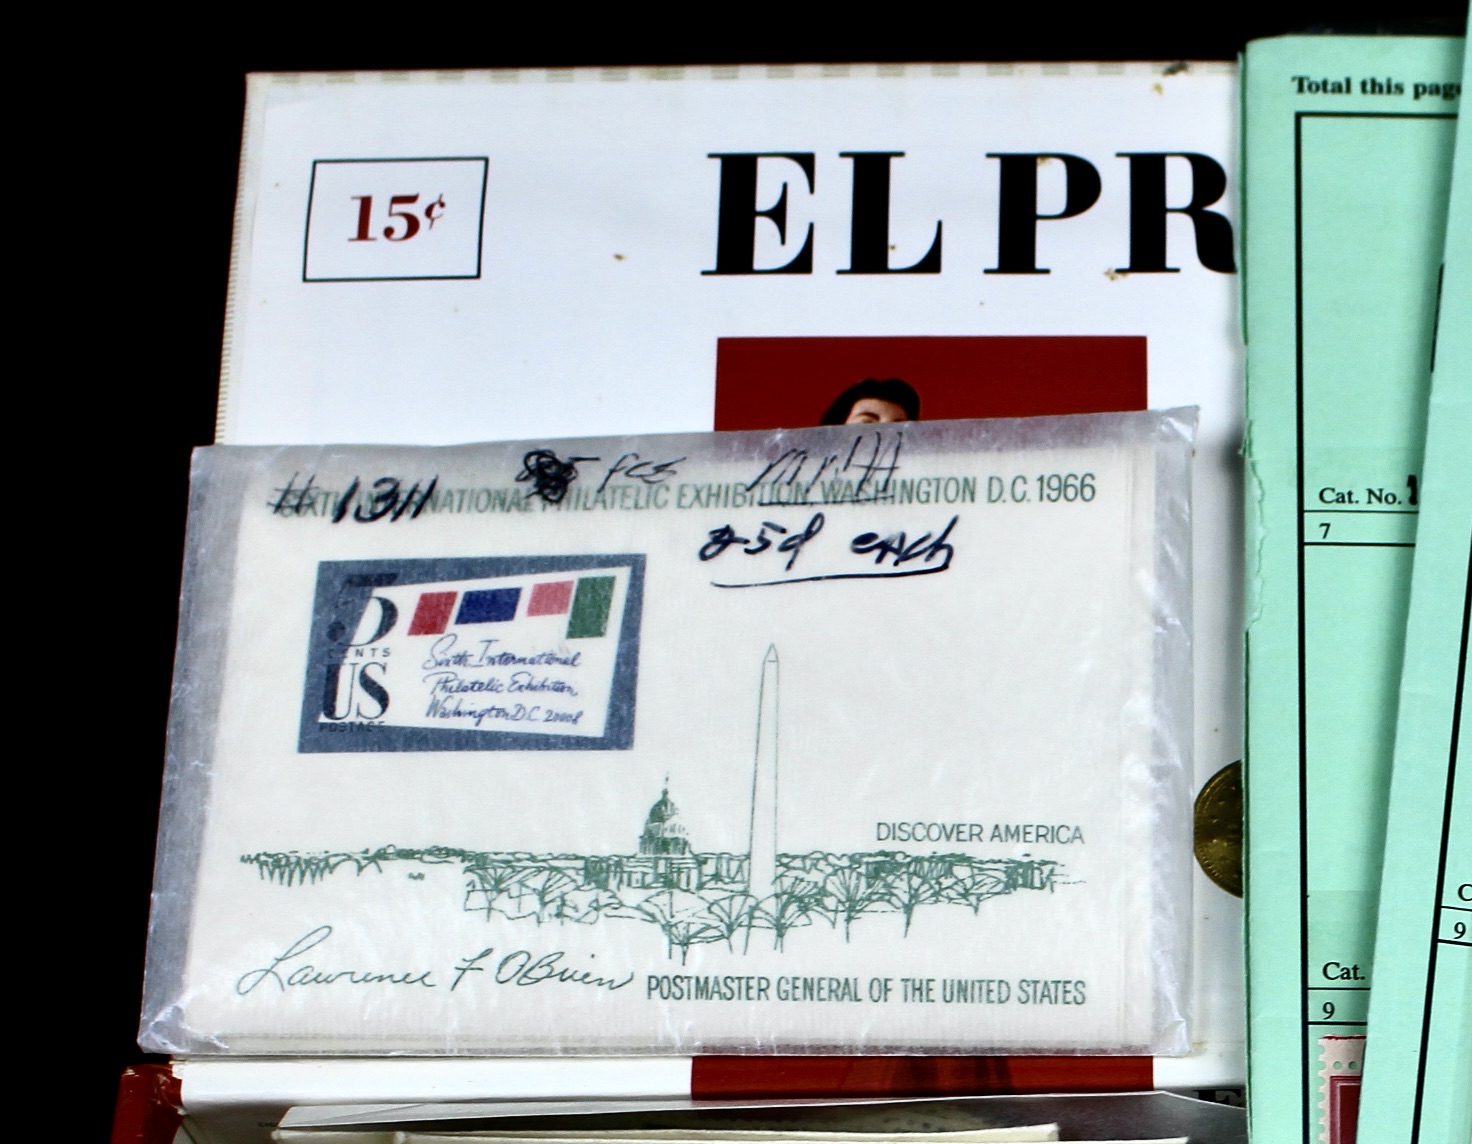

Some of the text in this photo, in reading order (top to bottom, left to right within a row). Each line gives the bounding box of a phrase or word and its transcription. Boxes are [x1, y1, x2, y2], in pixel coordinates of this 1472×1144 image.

[1291, 76, 1404, 97] Total this
[346, 193, 446, 243] 15¢
[701, 151, 942, 275] EL
[987, 475, 1031, 503] D.C.
[1038, 473, 1096, 504] 1966
[1319, 487, 1401, 505] Cat. No.
[1320, 524, 1330, 539] 7
[470, 639, 581, 669] International
[322, 662, 389, 721] US
[422, 672, 503, 695] Philatelic
[876, 821, 1085, 845] DISCOVER AMERICA
[1454, 922, 1466, 940] 9
[1322, 962, 1365, 981] Cat.
[647, 974, 1086, 1006] POSTMASTER GENERAL OF THE UNITED STATES
